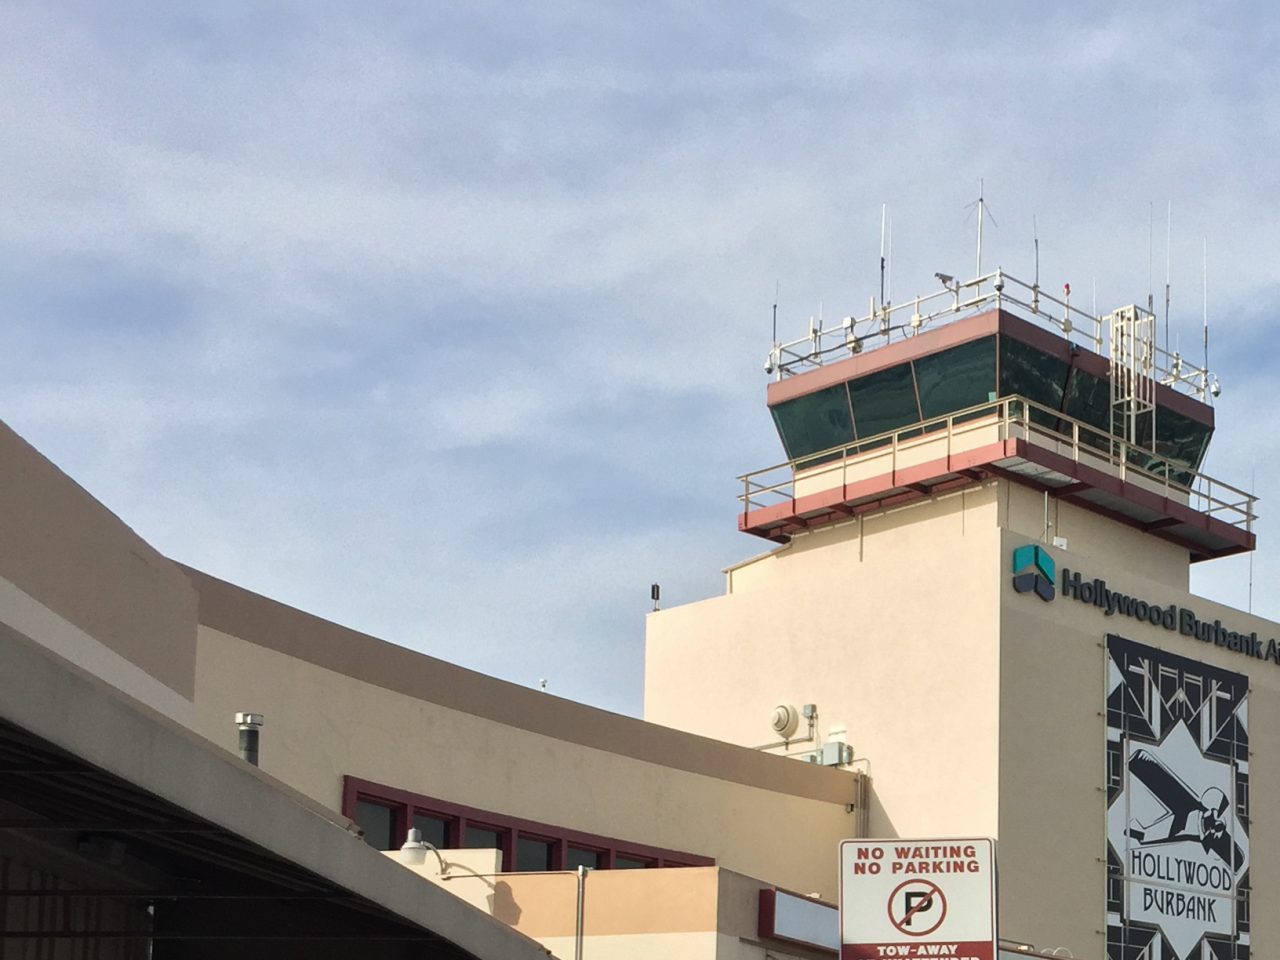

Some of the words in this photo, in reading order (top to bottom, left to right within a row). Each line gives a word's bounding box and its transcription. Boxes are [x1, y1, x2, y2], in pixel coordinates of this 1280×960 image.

[1062, 568, 1177, 631] Hollywood
[1179, 608, 1264, 660] Burbank
[857, 847, 884, 860] NO
[895, 845, 976, 859] WAITING
[854, 862, 881, 875] NO
[892, 860, 980, 874] PARKING
[1132, 851, 1232, 891] HOLLYWOOD
[1143, 887, 1216, 923] BURBANK
[877, 945, 958, 957] TOW-AWAY
